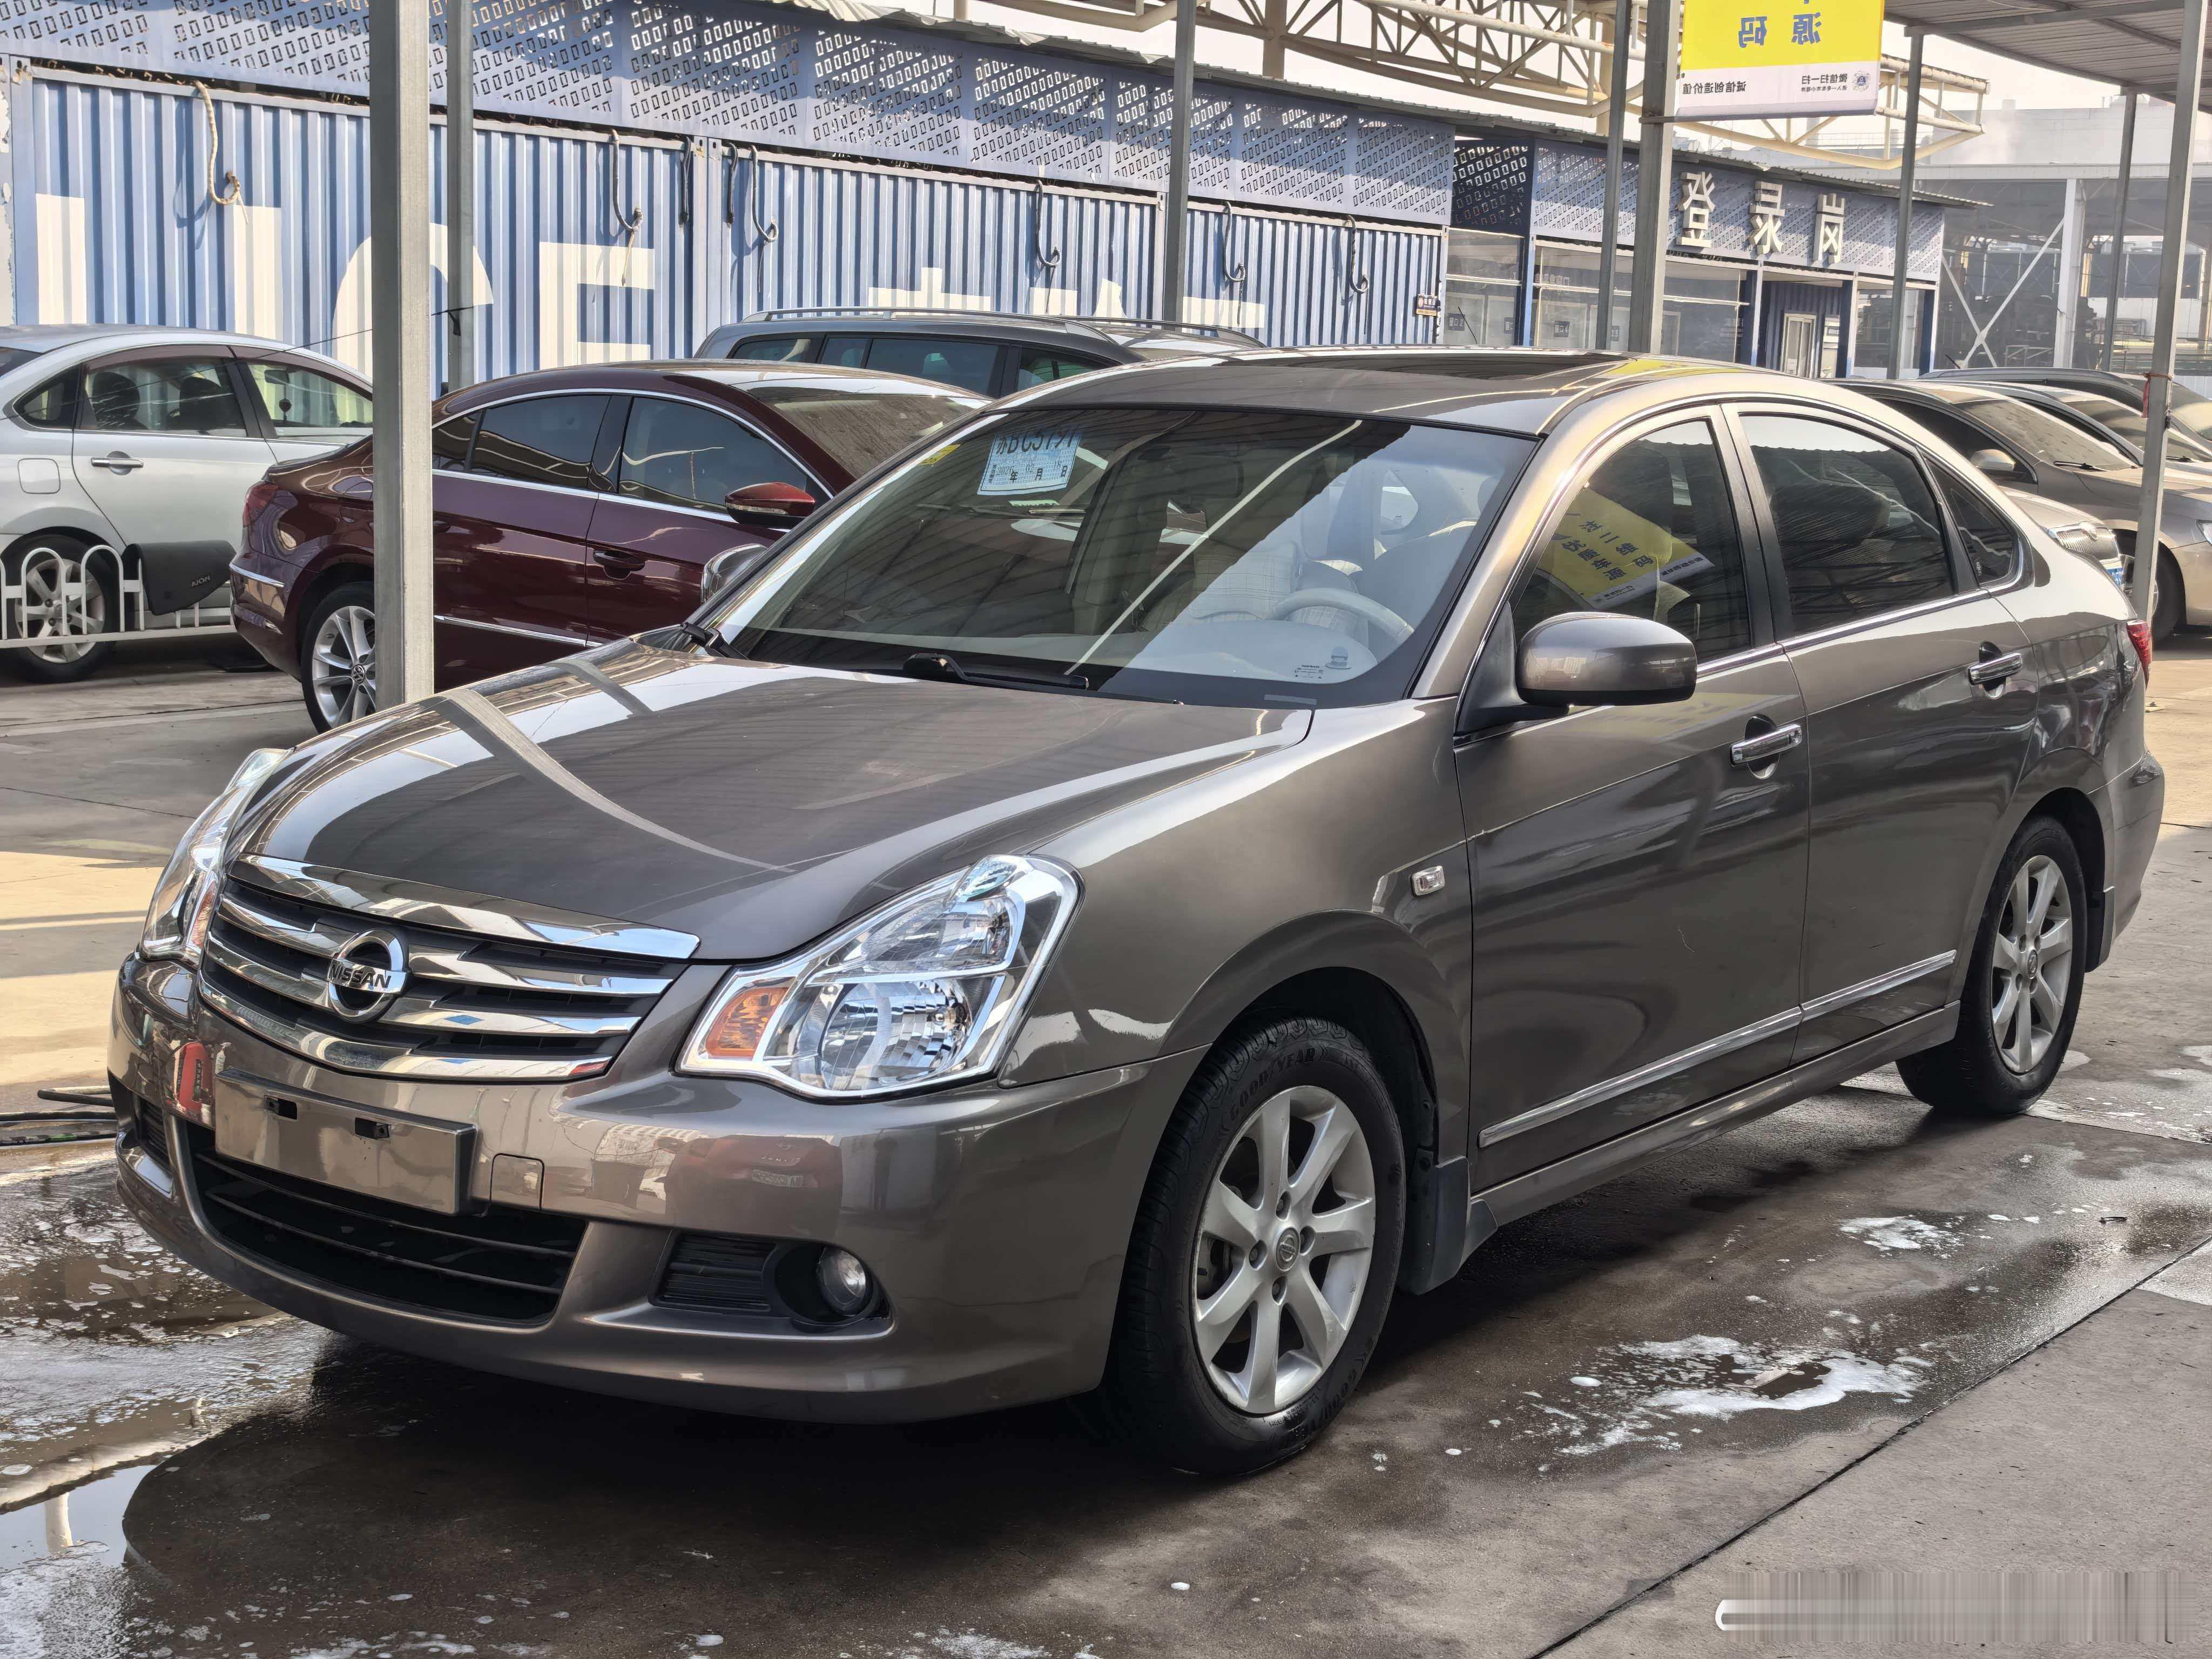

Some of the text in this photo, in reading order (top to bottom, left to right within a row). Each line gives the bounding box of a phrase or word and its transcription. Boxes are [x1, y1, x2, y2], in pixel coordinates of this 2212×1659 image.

[1677, 171, 1845, 264] 登录岗
[329, 960, 392, 989] NISSAN
